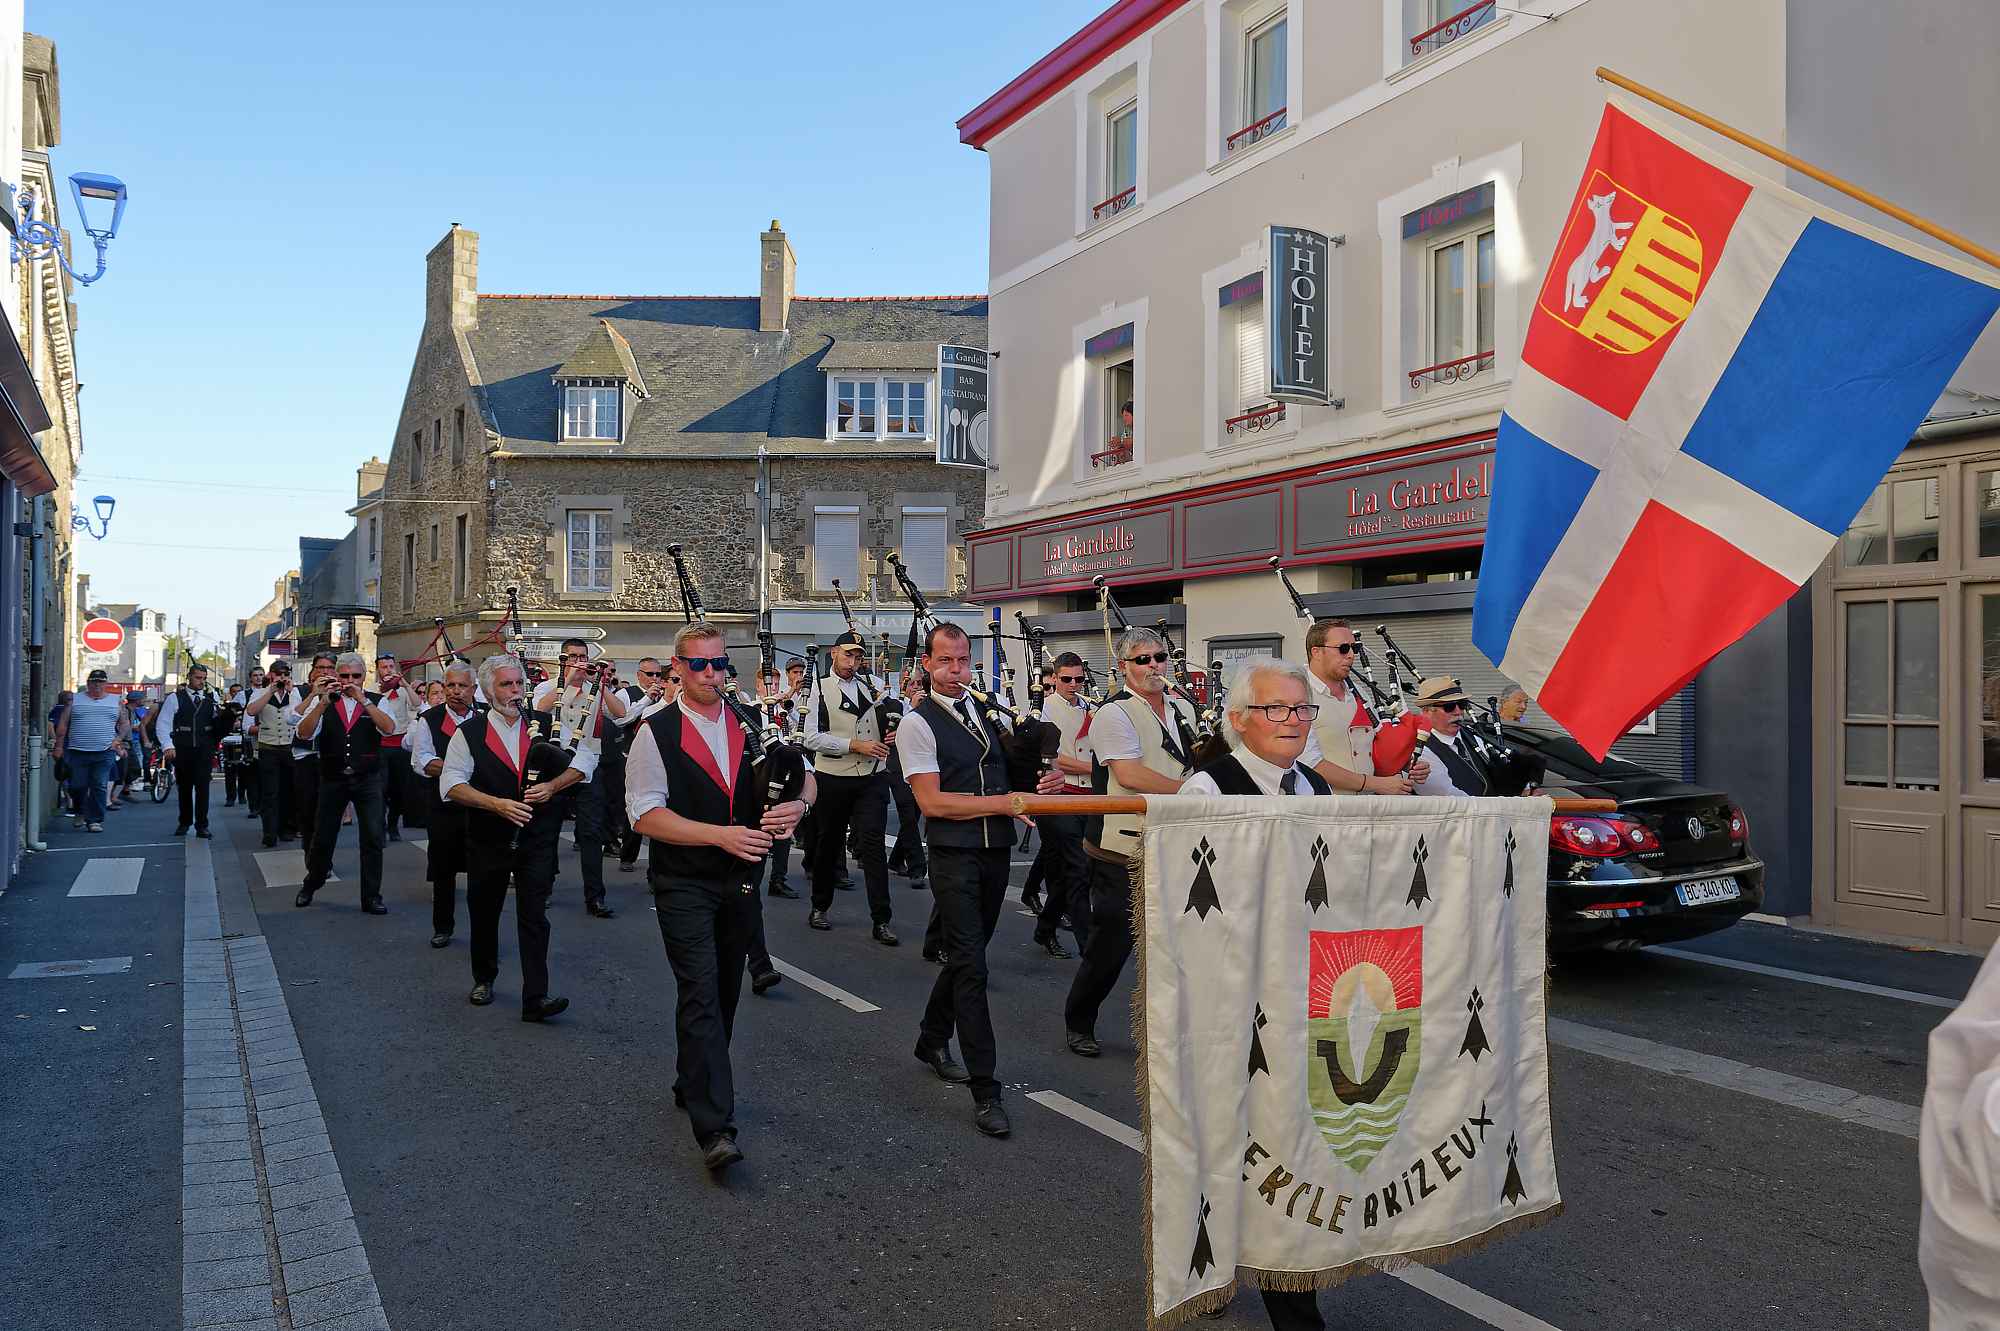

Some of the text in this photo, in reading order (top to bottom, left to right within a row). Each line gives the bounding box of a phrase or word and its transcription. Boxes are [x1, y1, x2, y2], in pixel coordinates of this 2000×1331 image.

[1290, 246, 1317, 385] HOTEL
[959, 376, 975, 385] BAR
[1345, 486, 1381, 518] La
[1401, 506, 1476, 531] Restaurant
[1043, 525, 1135, 562] La Gardelle
[1071, 557, 1113, 575] Restaurant
